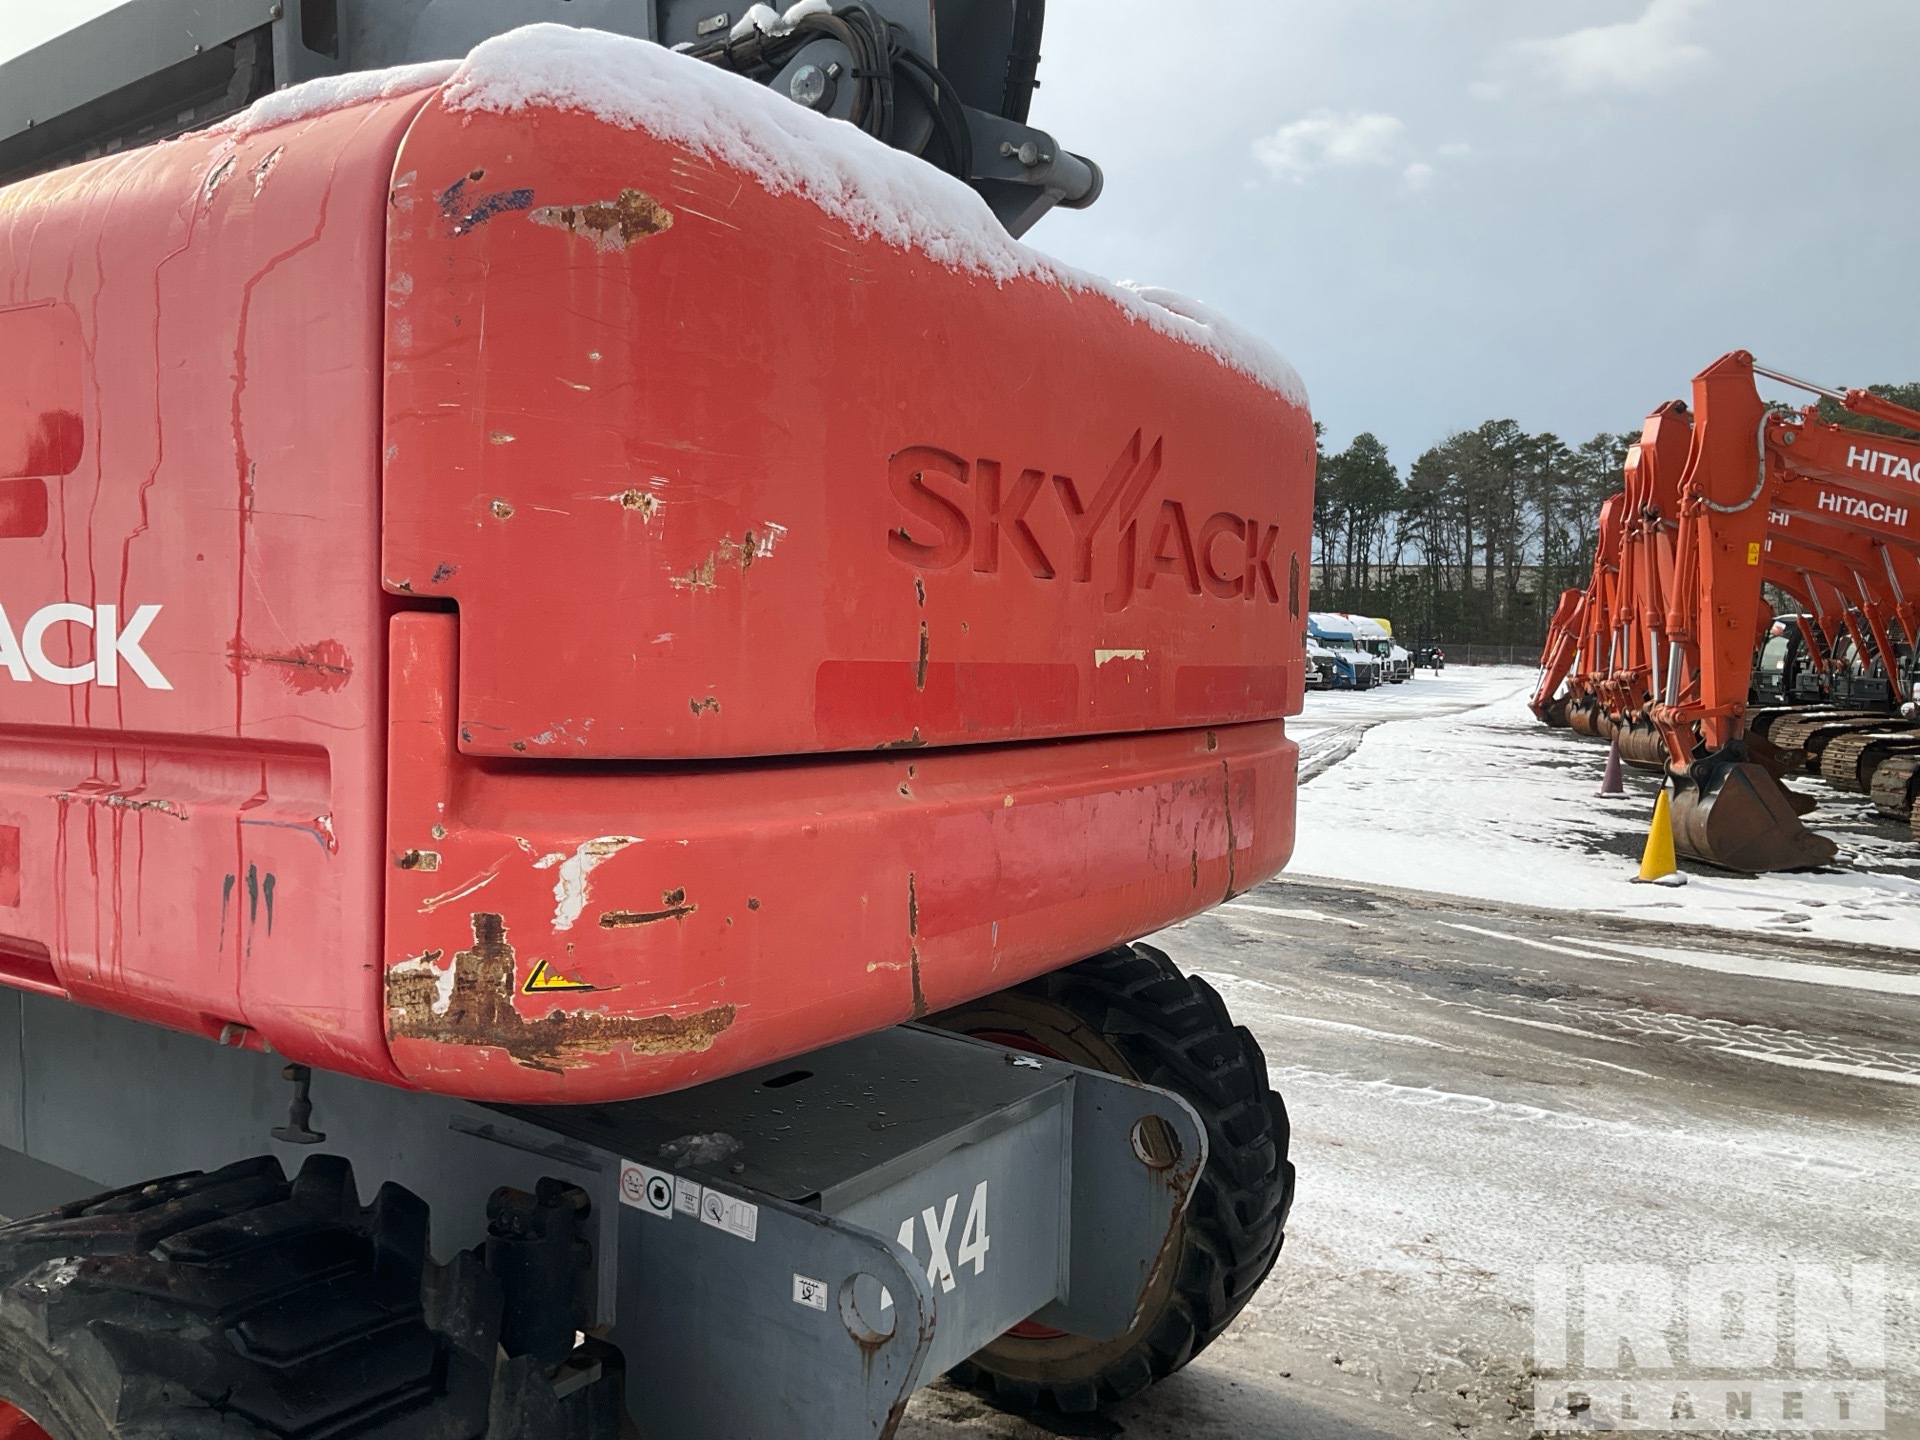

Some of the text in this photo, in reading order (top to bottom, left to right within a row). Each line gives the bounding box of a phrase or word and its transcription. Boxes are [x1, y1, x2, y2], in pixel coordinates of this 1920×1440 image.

[888, 427, 1280, 614] SKYJACK
[1767, 511, 1790, 527] HI
[1818, 491, 1908, 527] HITACHI
